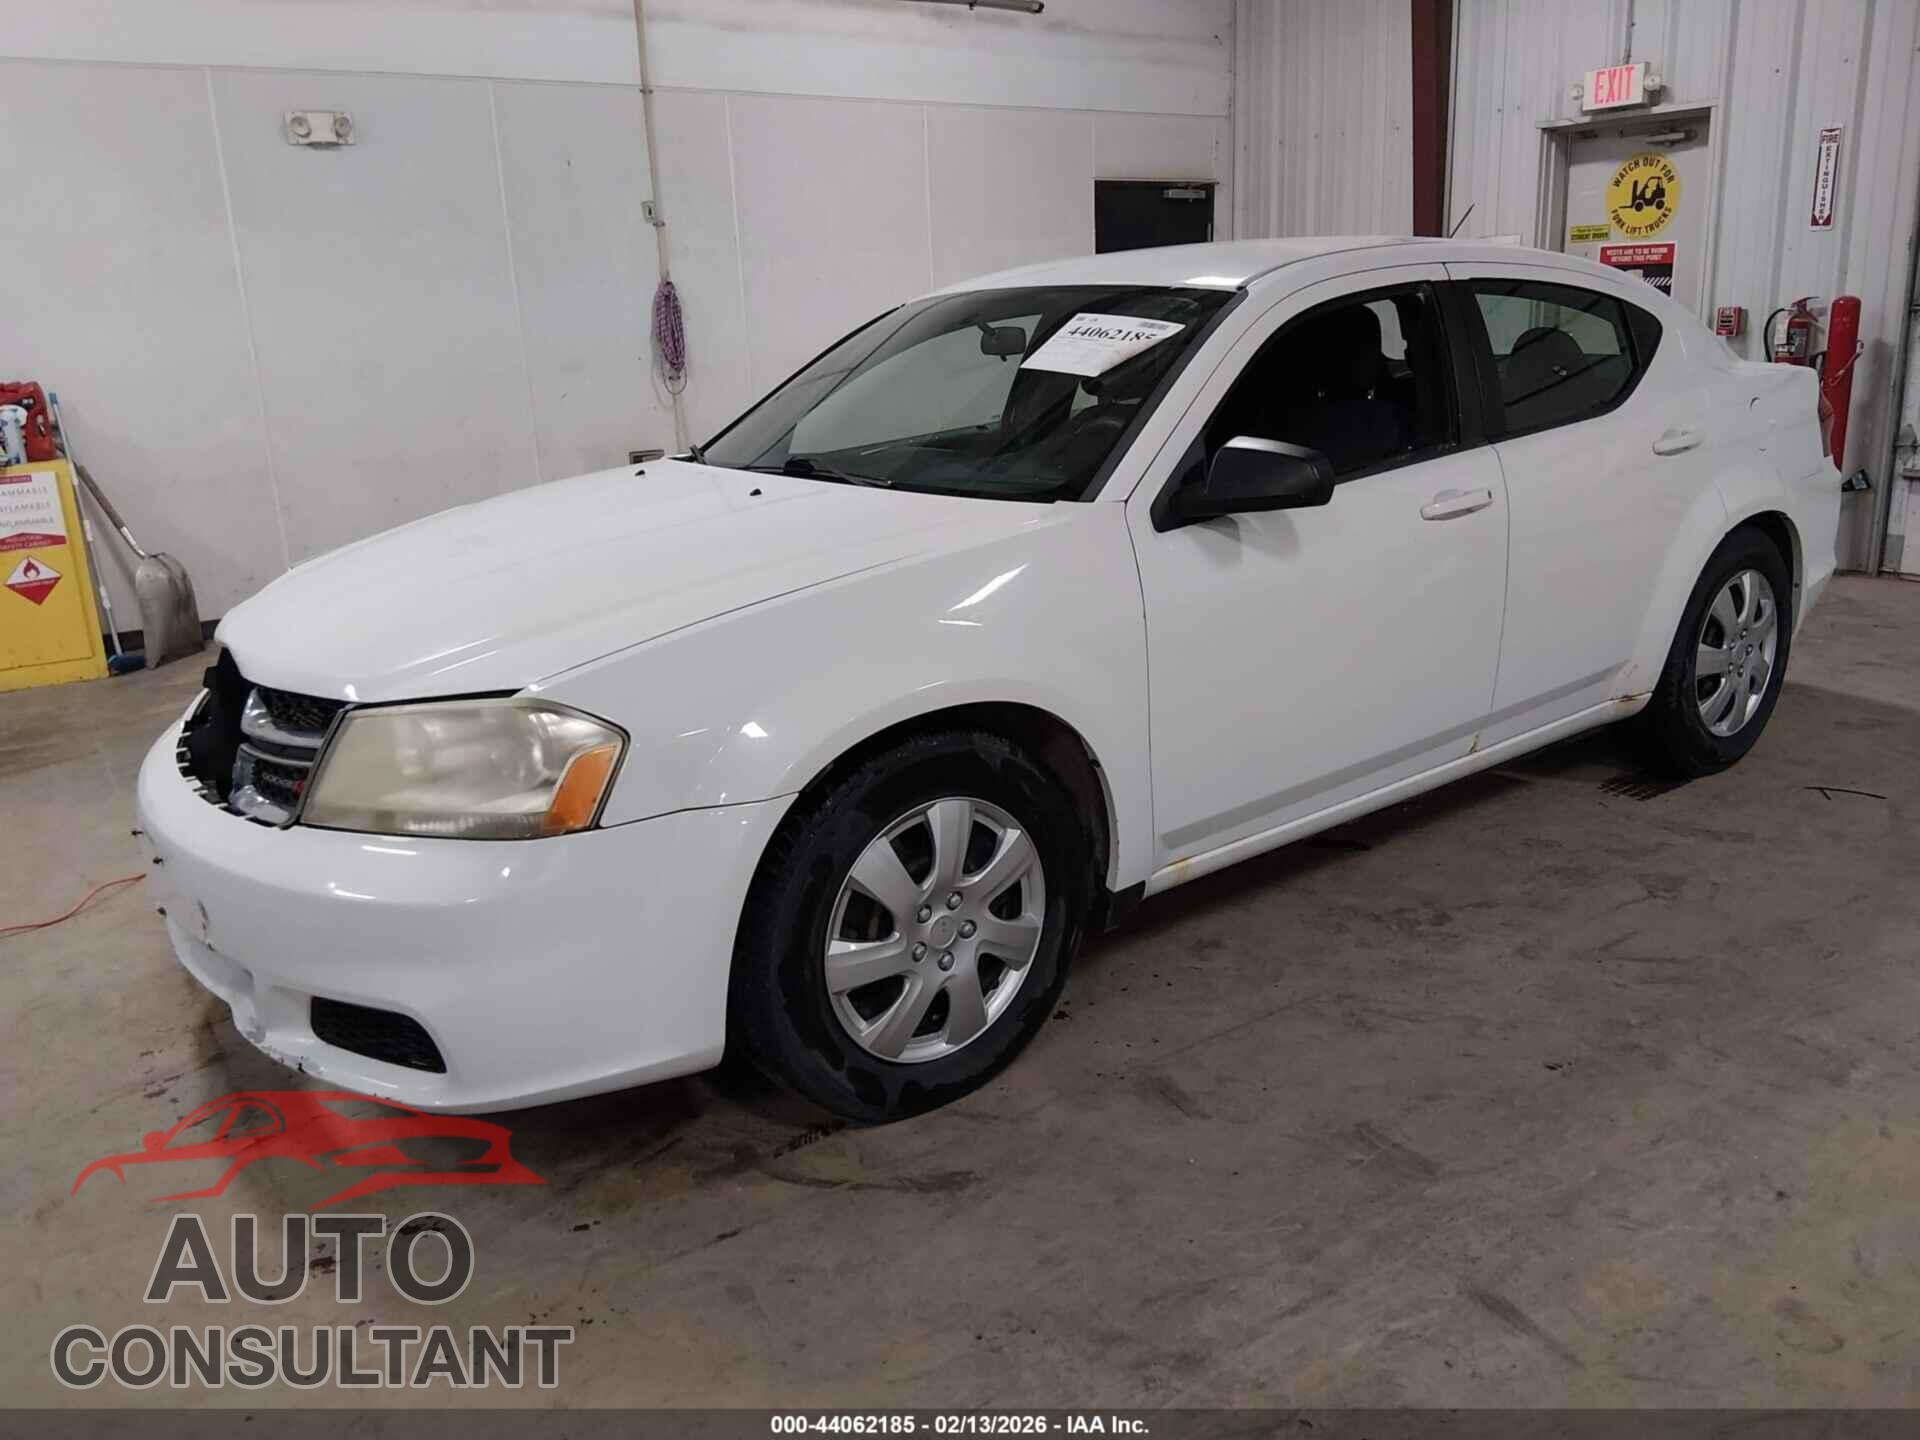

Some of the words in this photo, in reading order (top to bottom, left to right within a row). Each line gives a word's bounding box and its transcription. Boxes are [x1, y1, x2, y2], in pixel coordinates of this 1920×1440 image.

[1594, 66, 1634, 104] EXIT
[1820, 132, 1839, 144] FIRE
[1612, 159, 1641, 188] WATCH
[1642, 156, 1661, 169] OUT
[1660, 163, 1675, 184] FOR
[1818, 145, 1832, 220] EXTINGUISHER
[1610, 208, 1626, 230] FORK
